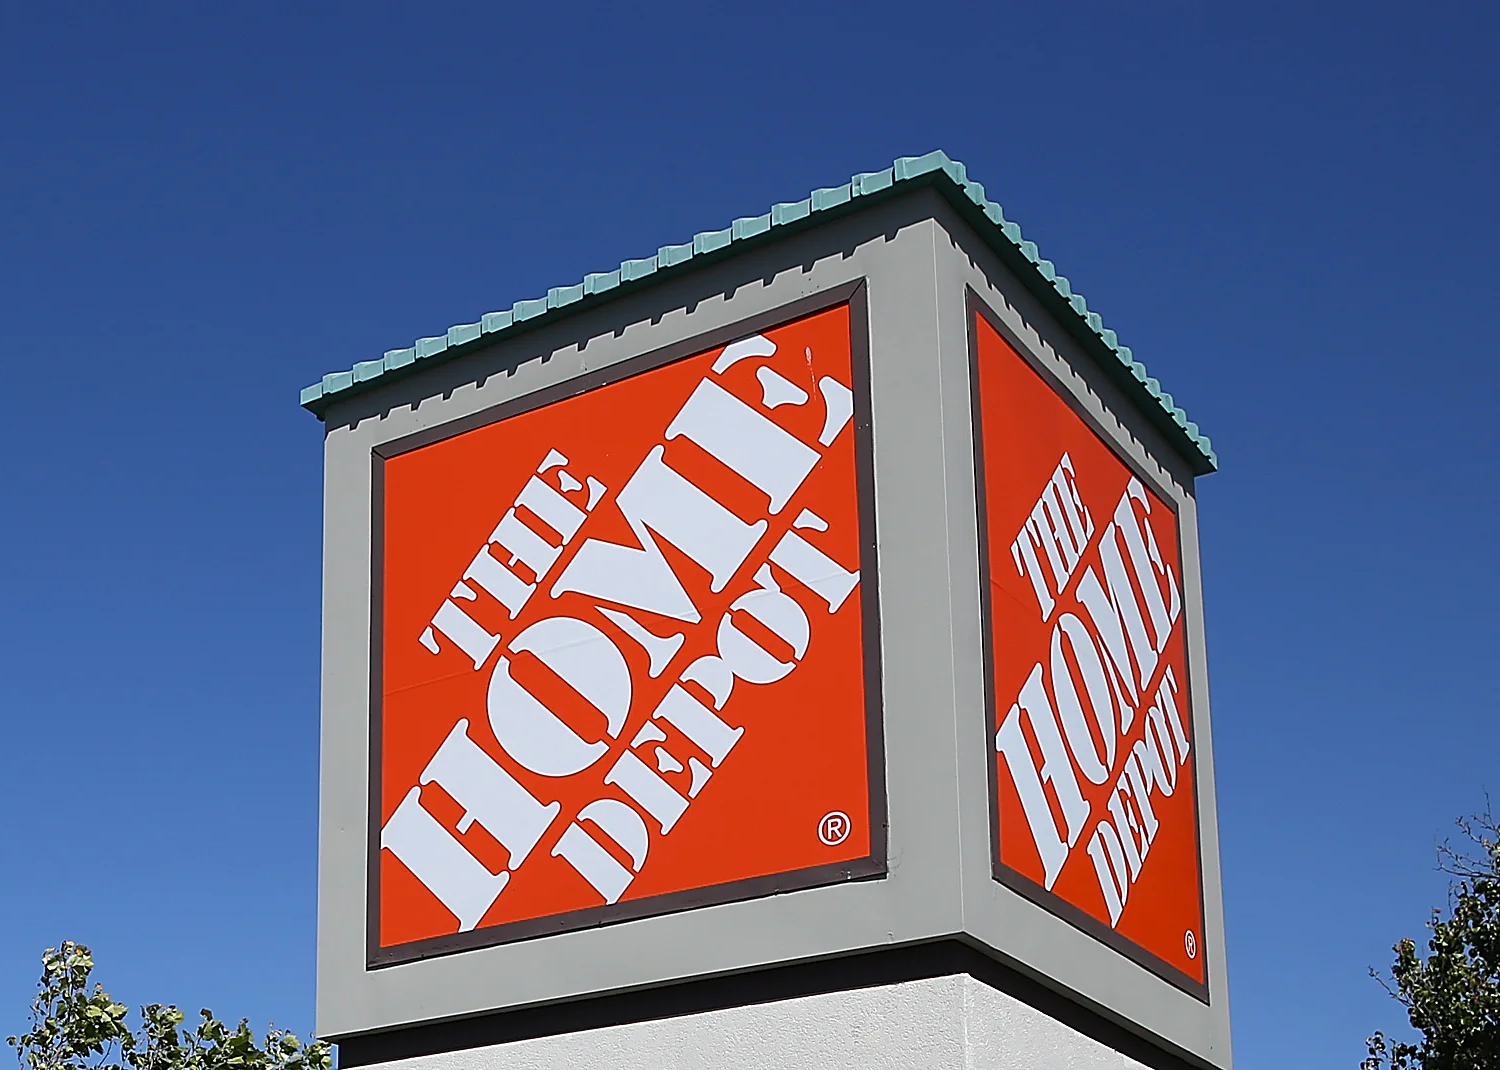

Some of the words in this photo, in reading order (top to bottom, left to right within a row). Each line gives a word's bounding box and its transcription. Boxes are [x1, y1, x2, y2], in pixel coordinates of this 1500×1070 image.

[381, 333, 855, 932] HOME
[418, 448, 608, 670] THE
[996, 476, 1181, 891] HOME
[1010, 452, 1095, 622] THE
[550, 507, 860, 904] DEPOT
[1087, 665, 1190, 928] DEPOT
